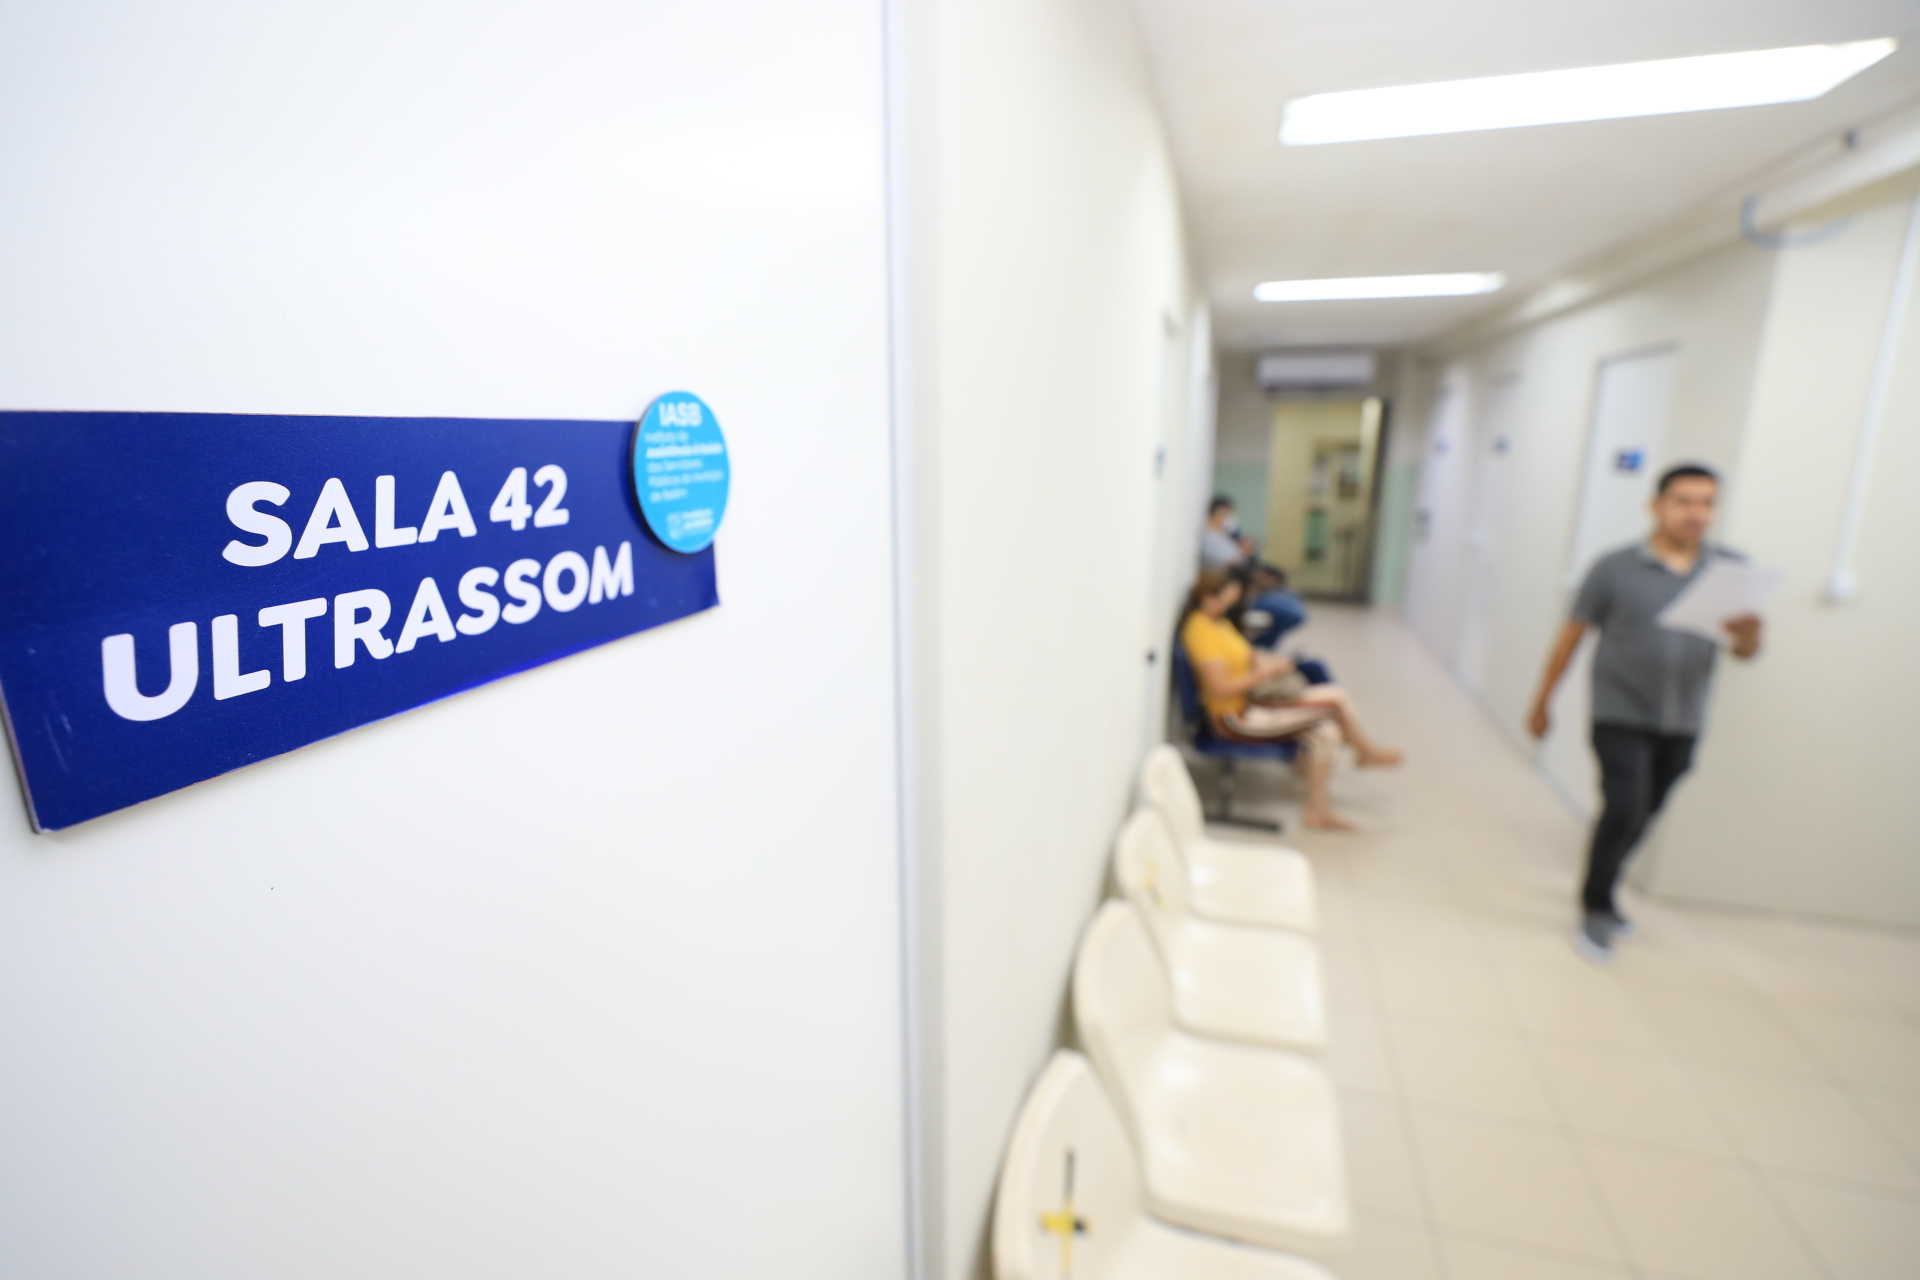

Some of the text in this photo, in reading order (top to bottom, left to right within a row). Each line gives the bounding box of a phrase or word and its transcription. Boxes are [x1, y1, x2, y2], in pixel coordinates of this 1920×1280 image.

[658, 402, 703, 427] IASB
[222, 464, 570, 567] SALA 42
[101, 542, 634, 722] ULTRASSOM
